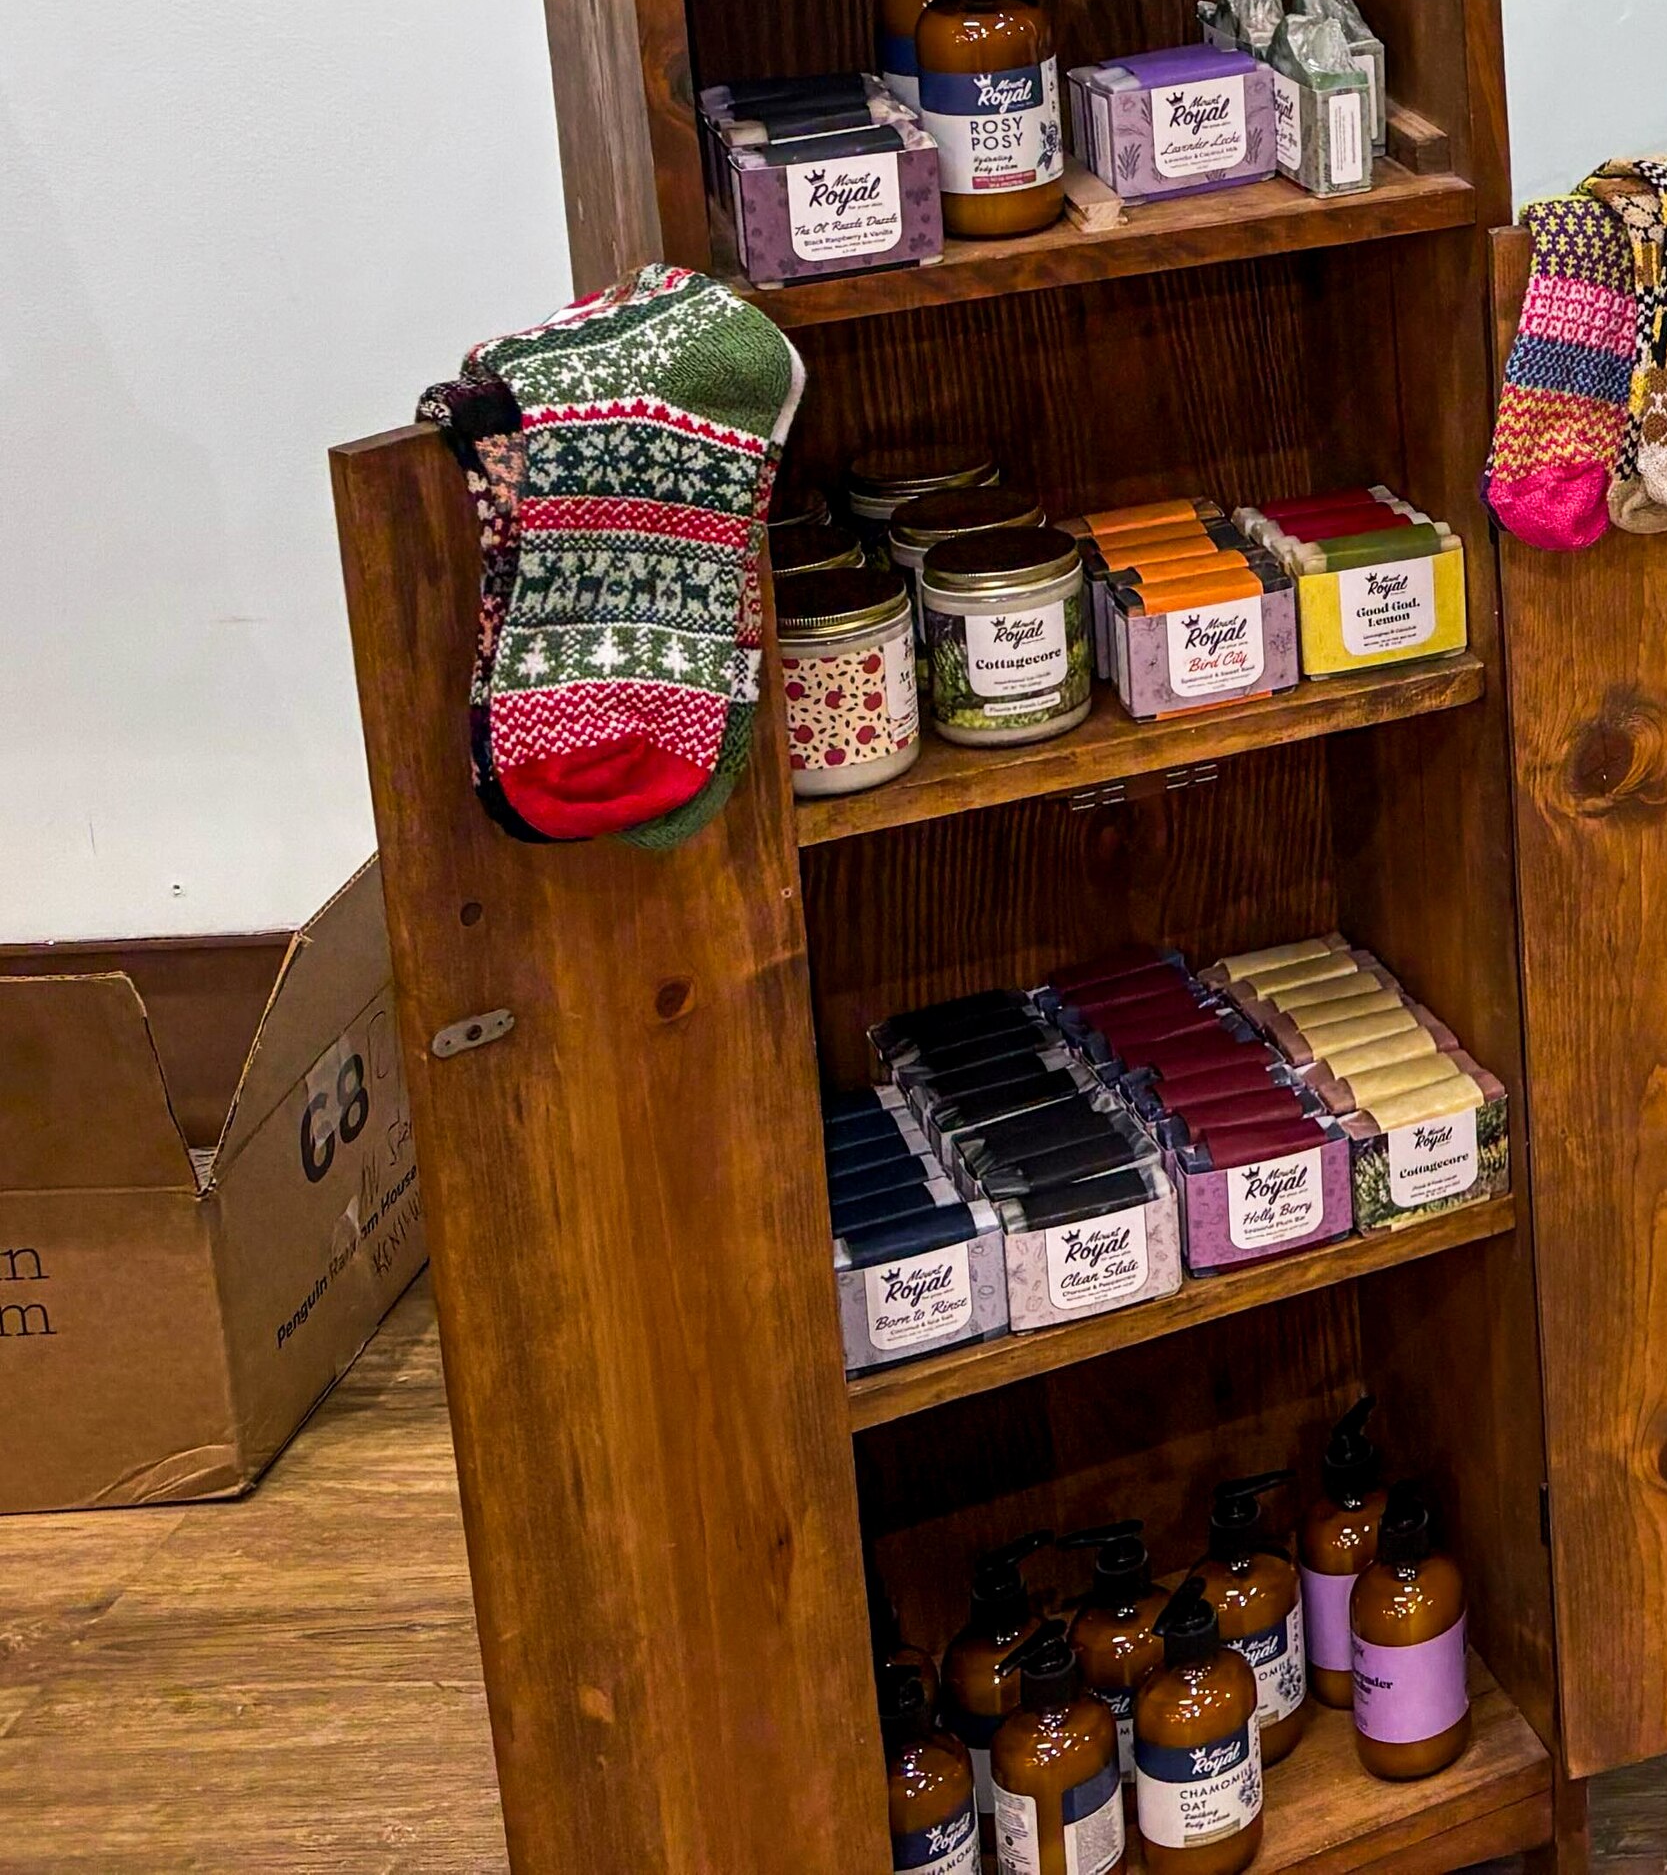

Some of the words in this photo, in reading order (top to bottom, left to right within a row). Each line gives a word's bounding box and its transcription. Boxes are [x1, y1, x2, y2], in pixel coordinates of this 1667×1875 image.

[978, 80, 1032, 113] Royal
[970, 116, 1023, 135] ROSY
[1170, 97, 1230, 135] Royal
[971, 132, 1023, 151] POSY
[831, 172, 871, 189] Mount
[809, 176, 881, 216] Royal
[795, 226, 810, 236] The
[832, 218, 862, 231] Razzle
[867, 213, 897, 226] Dazzle
[1367, 576, 1409, 599] Royal
[1367, 612, 1410, 628] Lemon
[994, 620, 1043, 649] Royal
[1184, 618, 1247, 656] Royal
[975, 648, 1061, 670] Cottagecore
[1188, 657, 1220, 672] Bird
[1223, 651, 1248, 667] City
[1415, 1126, 1453, 1152] Royal
[1245, 1167, 1307, 1206] Royal
[277, 1276, 328, 1349] Penguin
[380, 1165, 417, 1218] House
[1065, 1228, 1130, 1268] Royal
[885, 1266, 953, 1307] Royal
[1192, 1741, 1240, 1777] Royal
[1180, 1800, 1207, 1812] OAT
